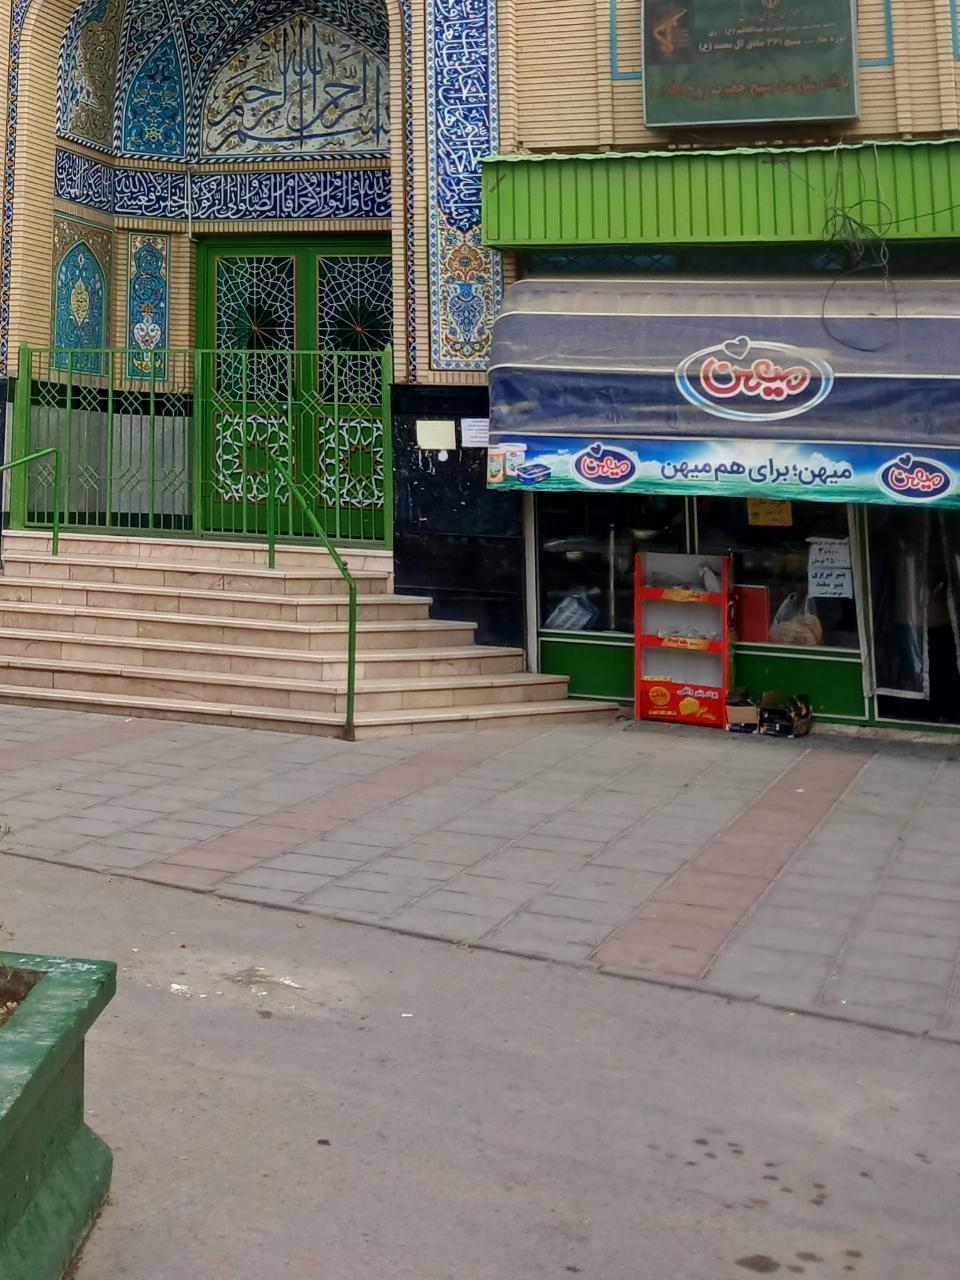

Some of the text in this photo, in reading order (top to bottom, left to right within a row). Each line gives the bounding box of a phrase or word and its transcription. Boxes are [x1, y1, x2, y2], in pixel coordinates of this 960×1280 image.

[697, 356, 811, 401] میهن
[580, 455, 632, 479] میهن
[661, 458, 714, 479] میهن
[714, 460, 745, 482] هم
[748, 458, 790, 483] برای
[888, 466, 945, 492] میهن
